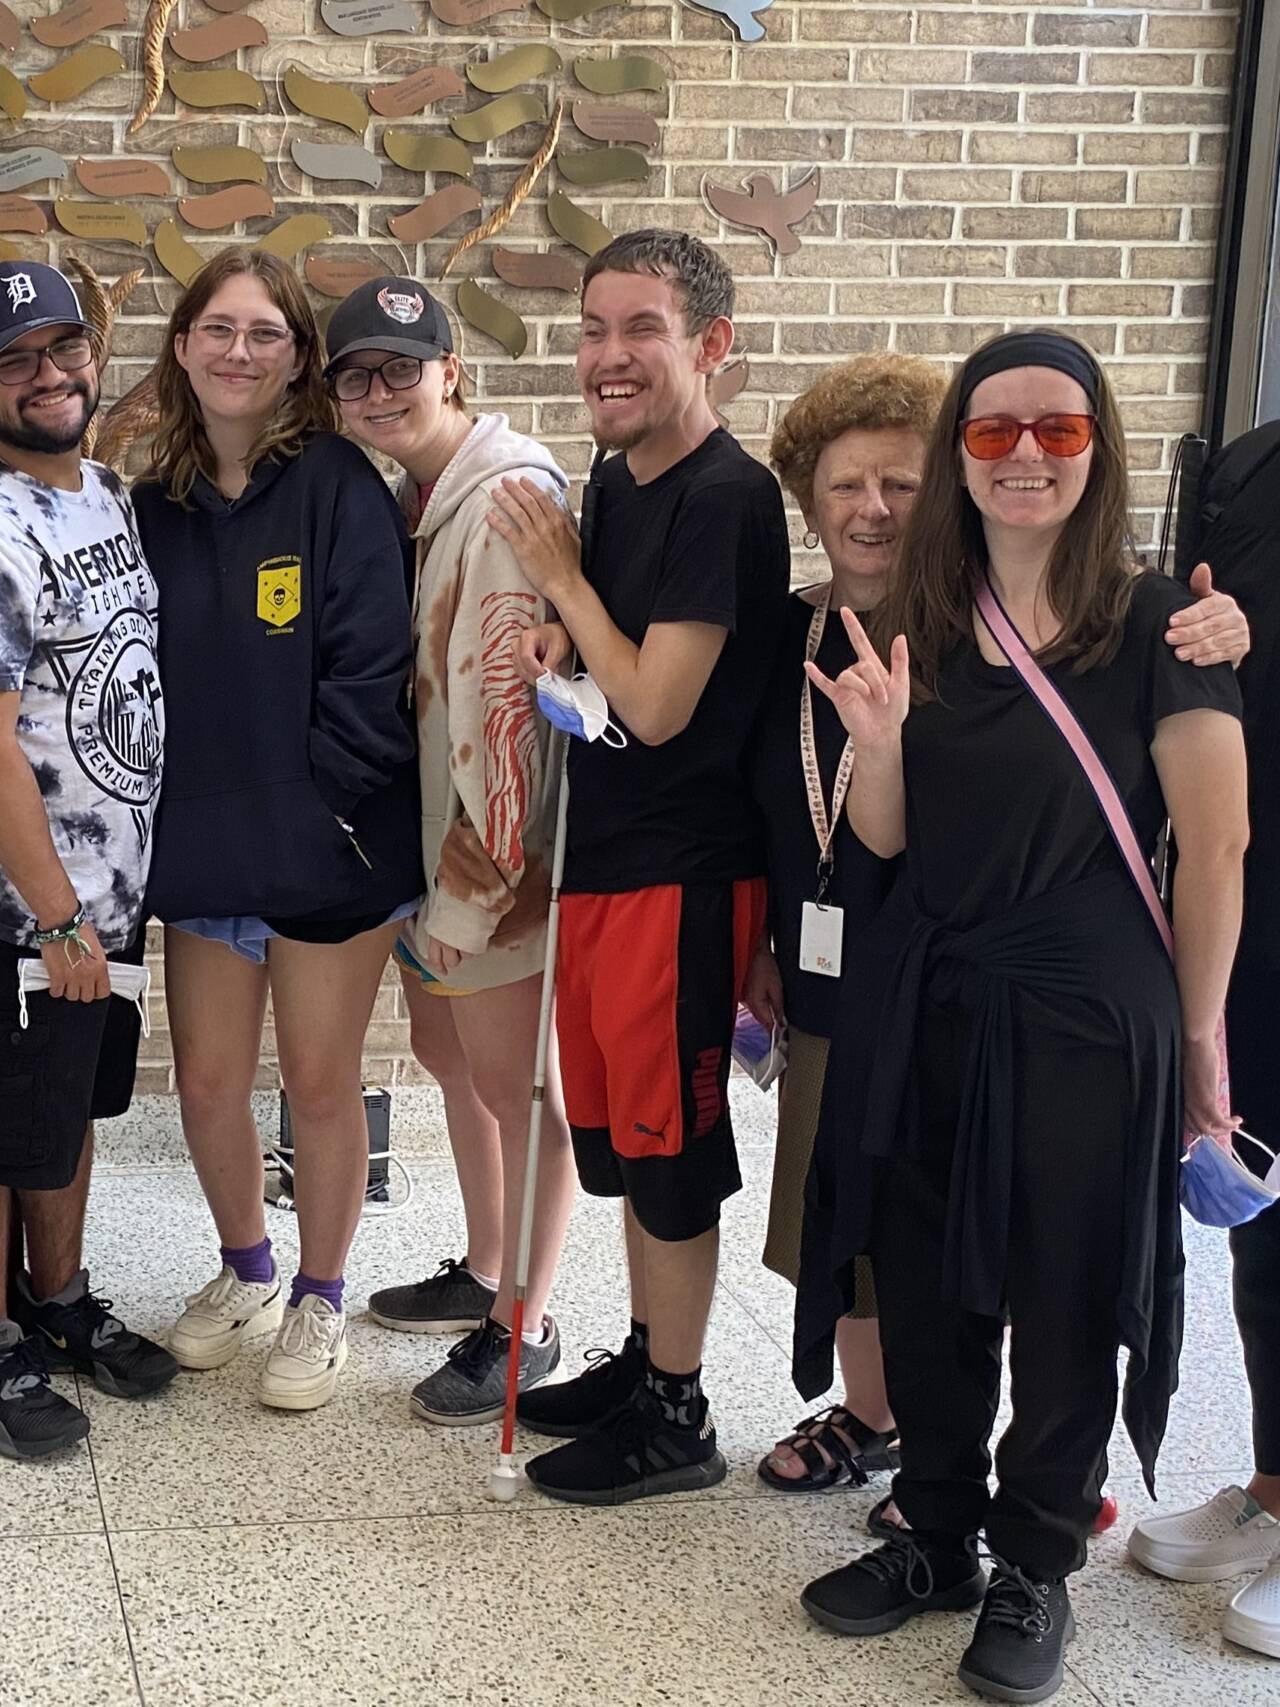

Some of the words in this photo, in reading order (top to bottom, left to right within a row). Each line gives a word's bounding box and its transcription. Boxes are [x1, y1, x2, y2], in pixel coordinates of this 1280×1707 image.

[0, 272, 37, 314] D
[78, 620, 128, 710] TRAINING
[78, 724, 142, 795] PREMIUM
